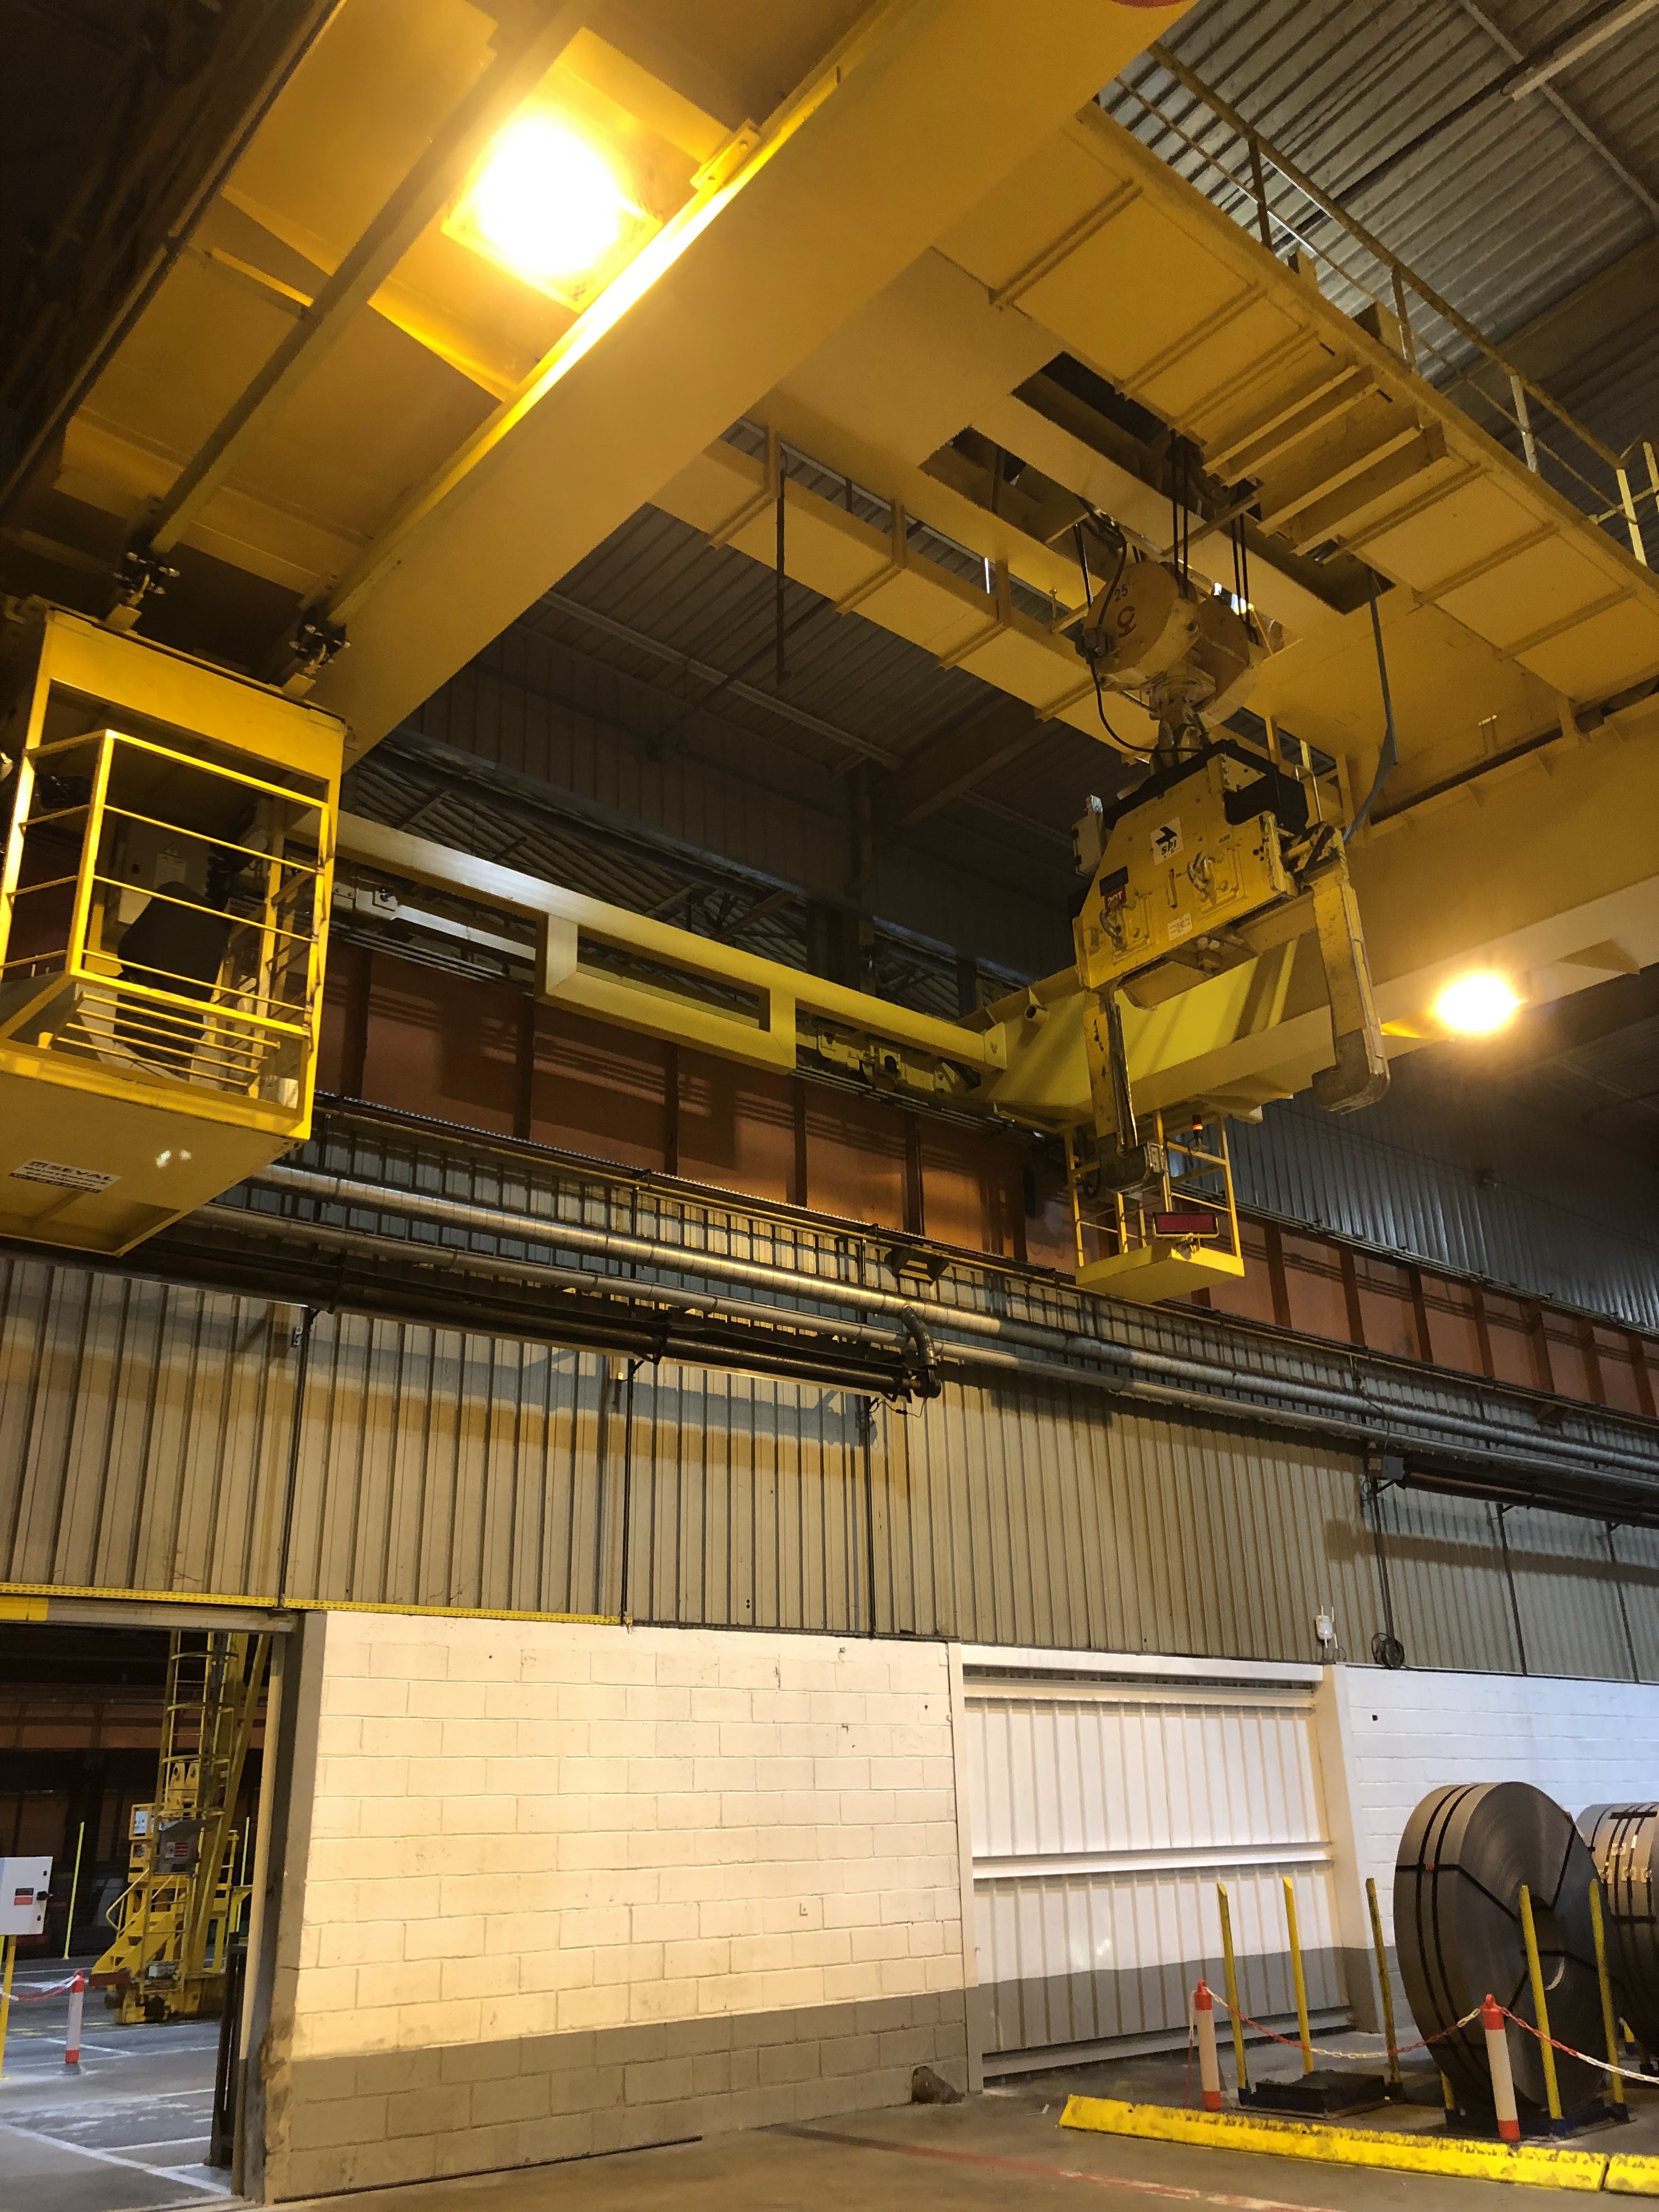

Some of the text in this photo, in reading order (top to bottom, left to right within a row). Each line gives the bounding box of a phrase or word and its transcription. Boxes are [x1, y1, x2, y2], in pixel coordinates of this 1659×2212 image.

[1114, 583, 1128, 602] 25
[1161, 839, 1177, 855] SPI
[50, 1165, 113, 1182] SEVAL
